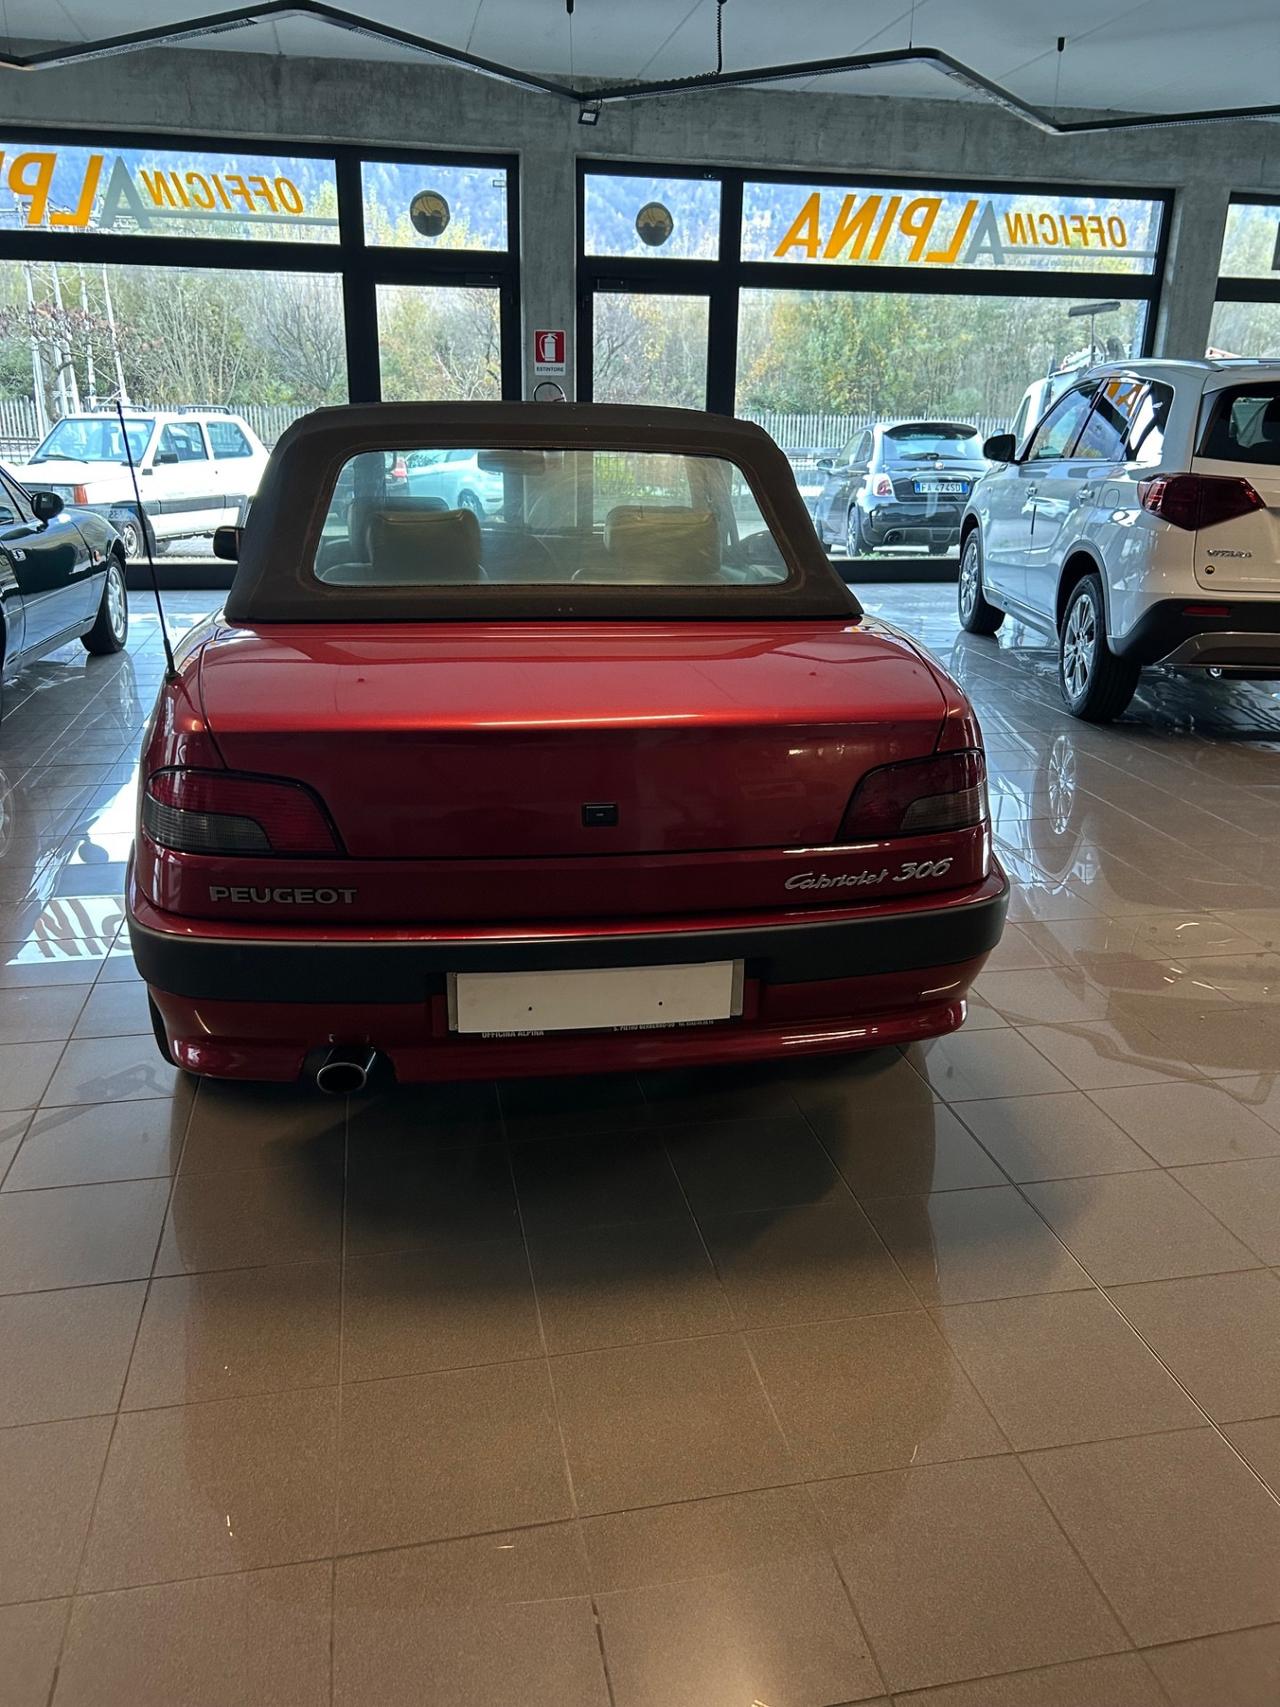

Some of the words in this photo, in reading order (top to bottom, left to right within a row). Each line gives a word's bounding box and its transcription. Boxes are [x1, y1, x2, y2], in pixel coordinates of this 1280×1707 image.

[1207, 549, 1252, 558] VITARA
[784, 868, 889, 890] Cabriolet
[209, 886, 358, 904] PEUGEOT
